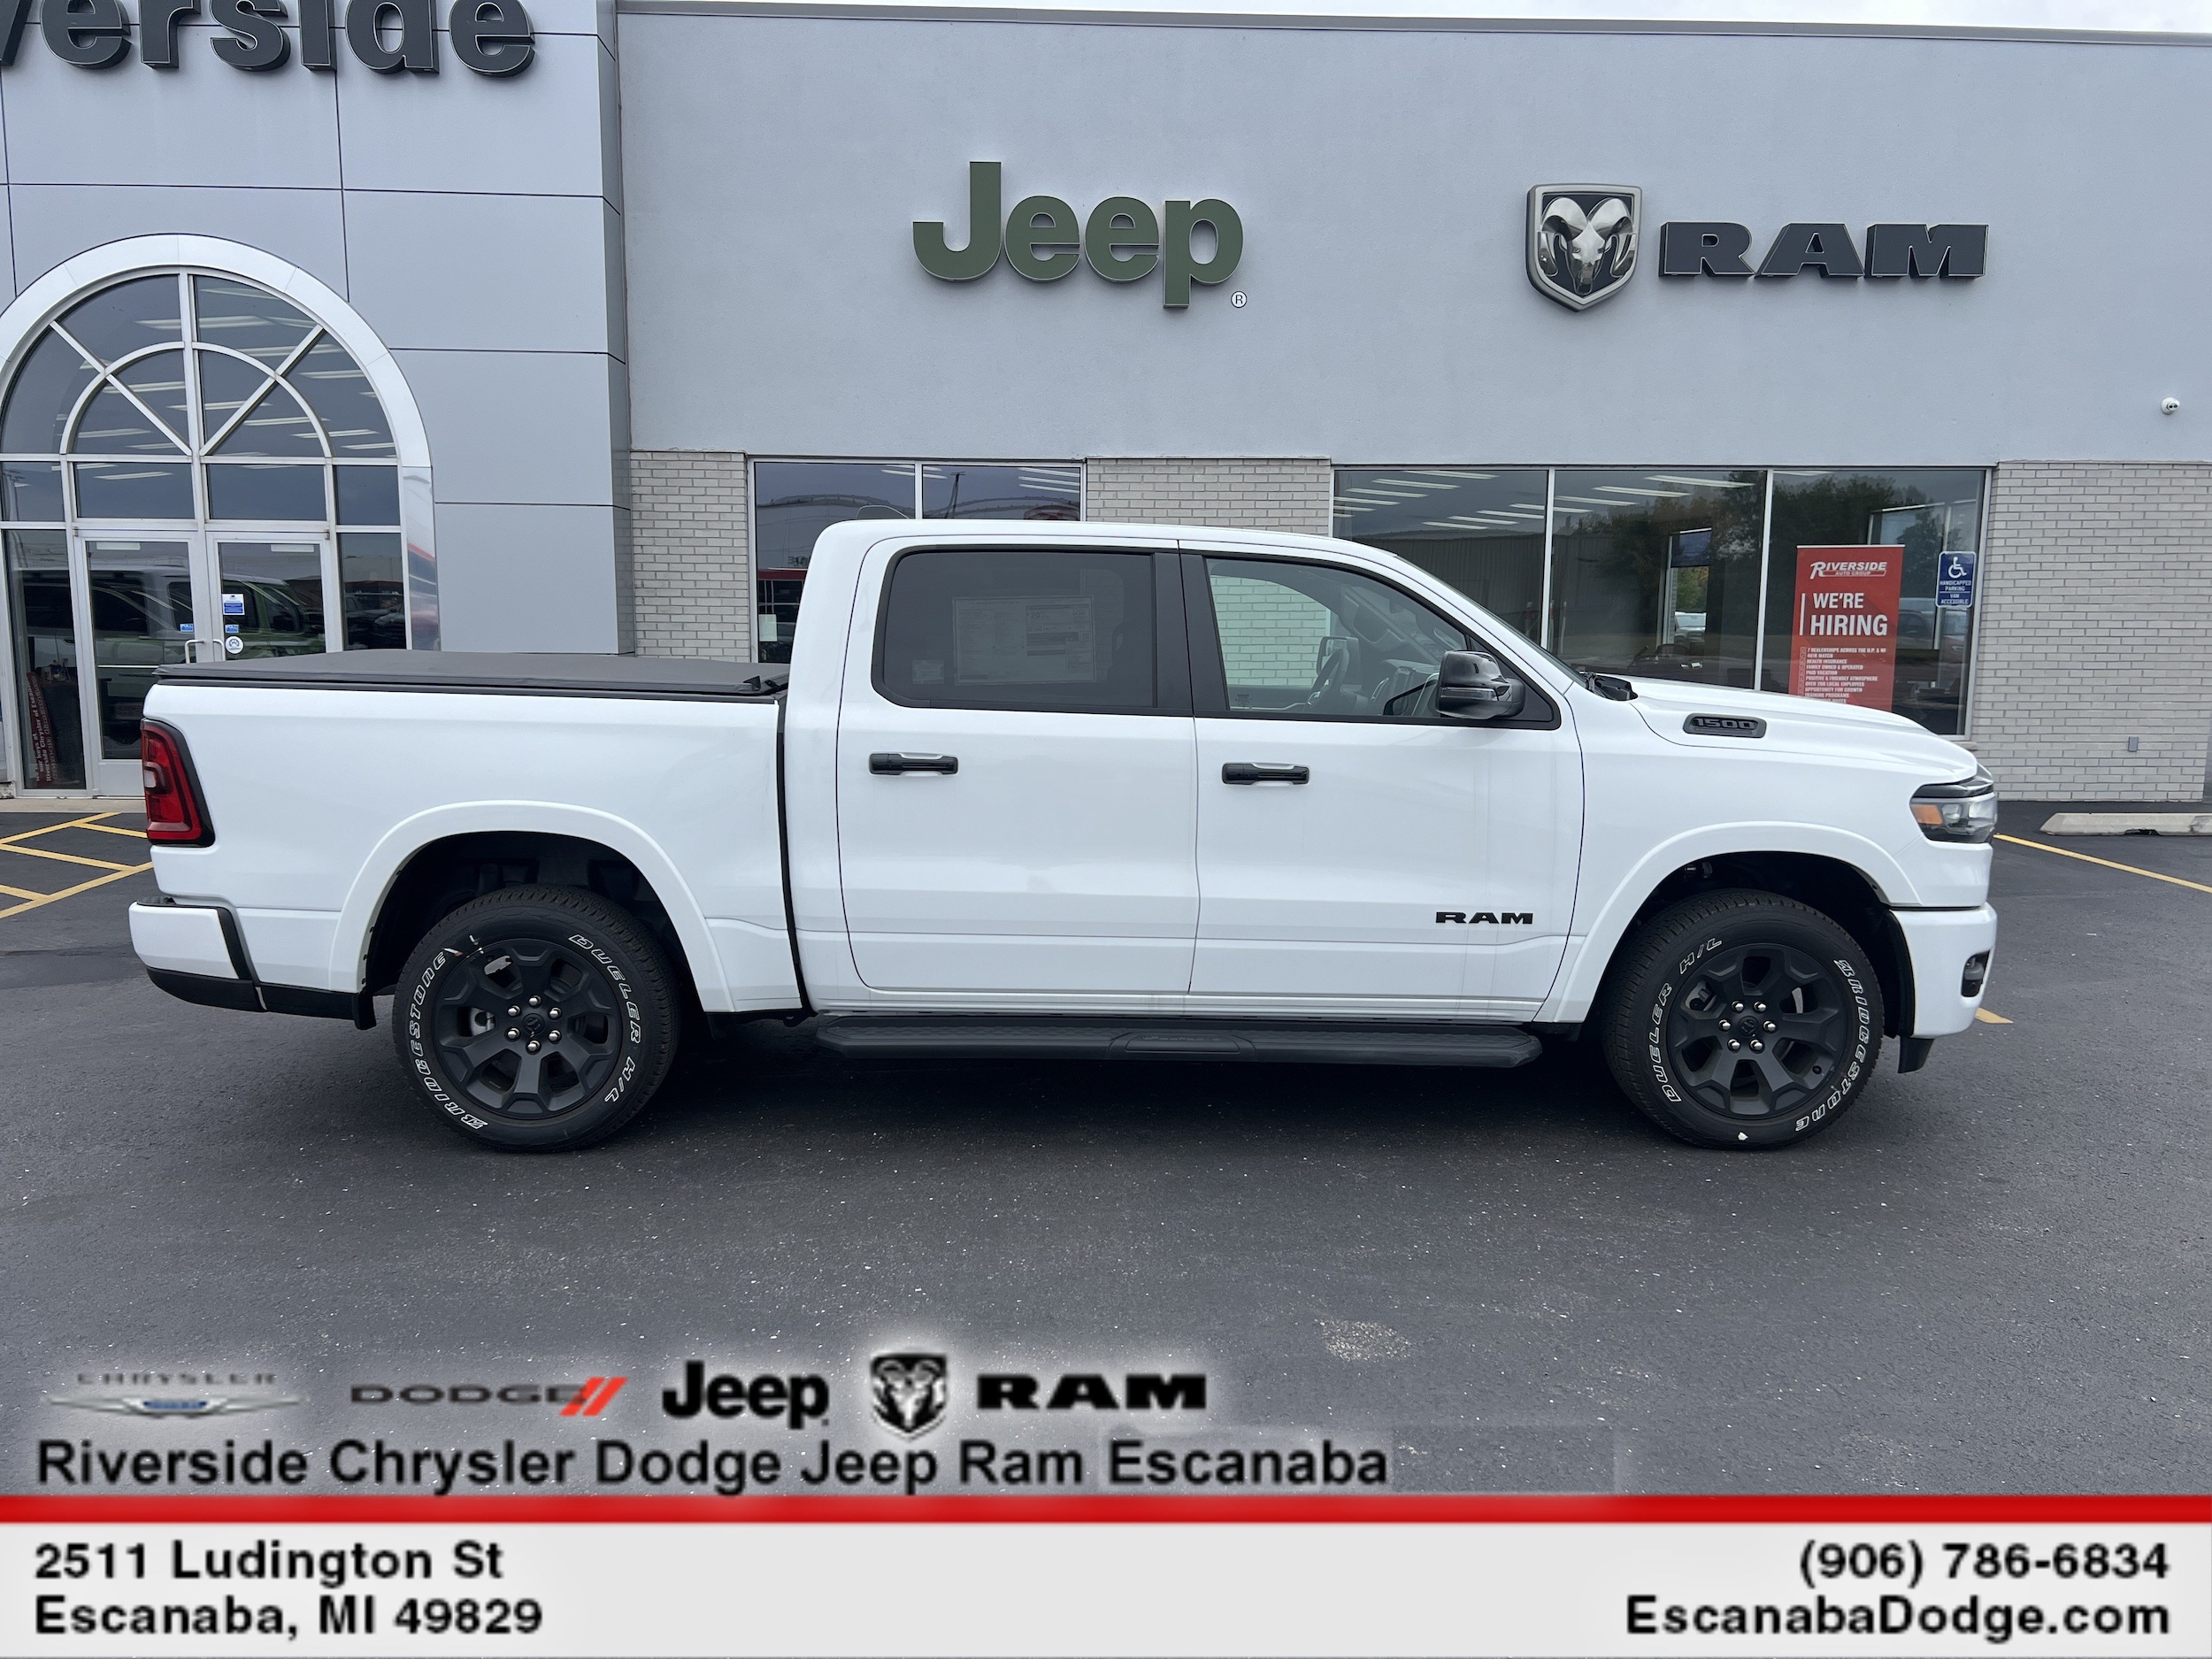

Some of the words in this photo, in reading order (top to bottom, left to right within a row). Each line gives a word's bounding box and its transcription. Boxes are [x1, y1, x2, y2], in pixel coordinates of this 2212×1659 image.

[912, 161, 1244, 310] Jeep
[1658, 220, 1990, 280] RAM
[1809, 561, 1888, 580] RIVERSIDE
[1812, 592, 1865, 609] WE'RE
[1810, 614, 1888, 636] HIRING
[1694, 717, 1755, 730] 1500
[1435, 911, 1533, 925] RAM
